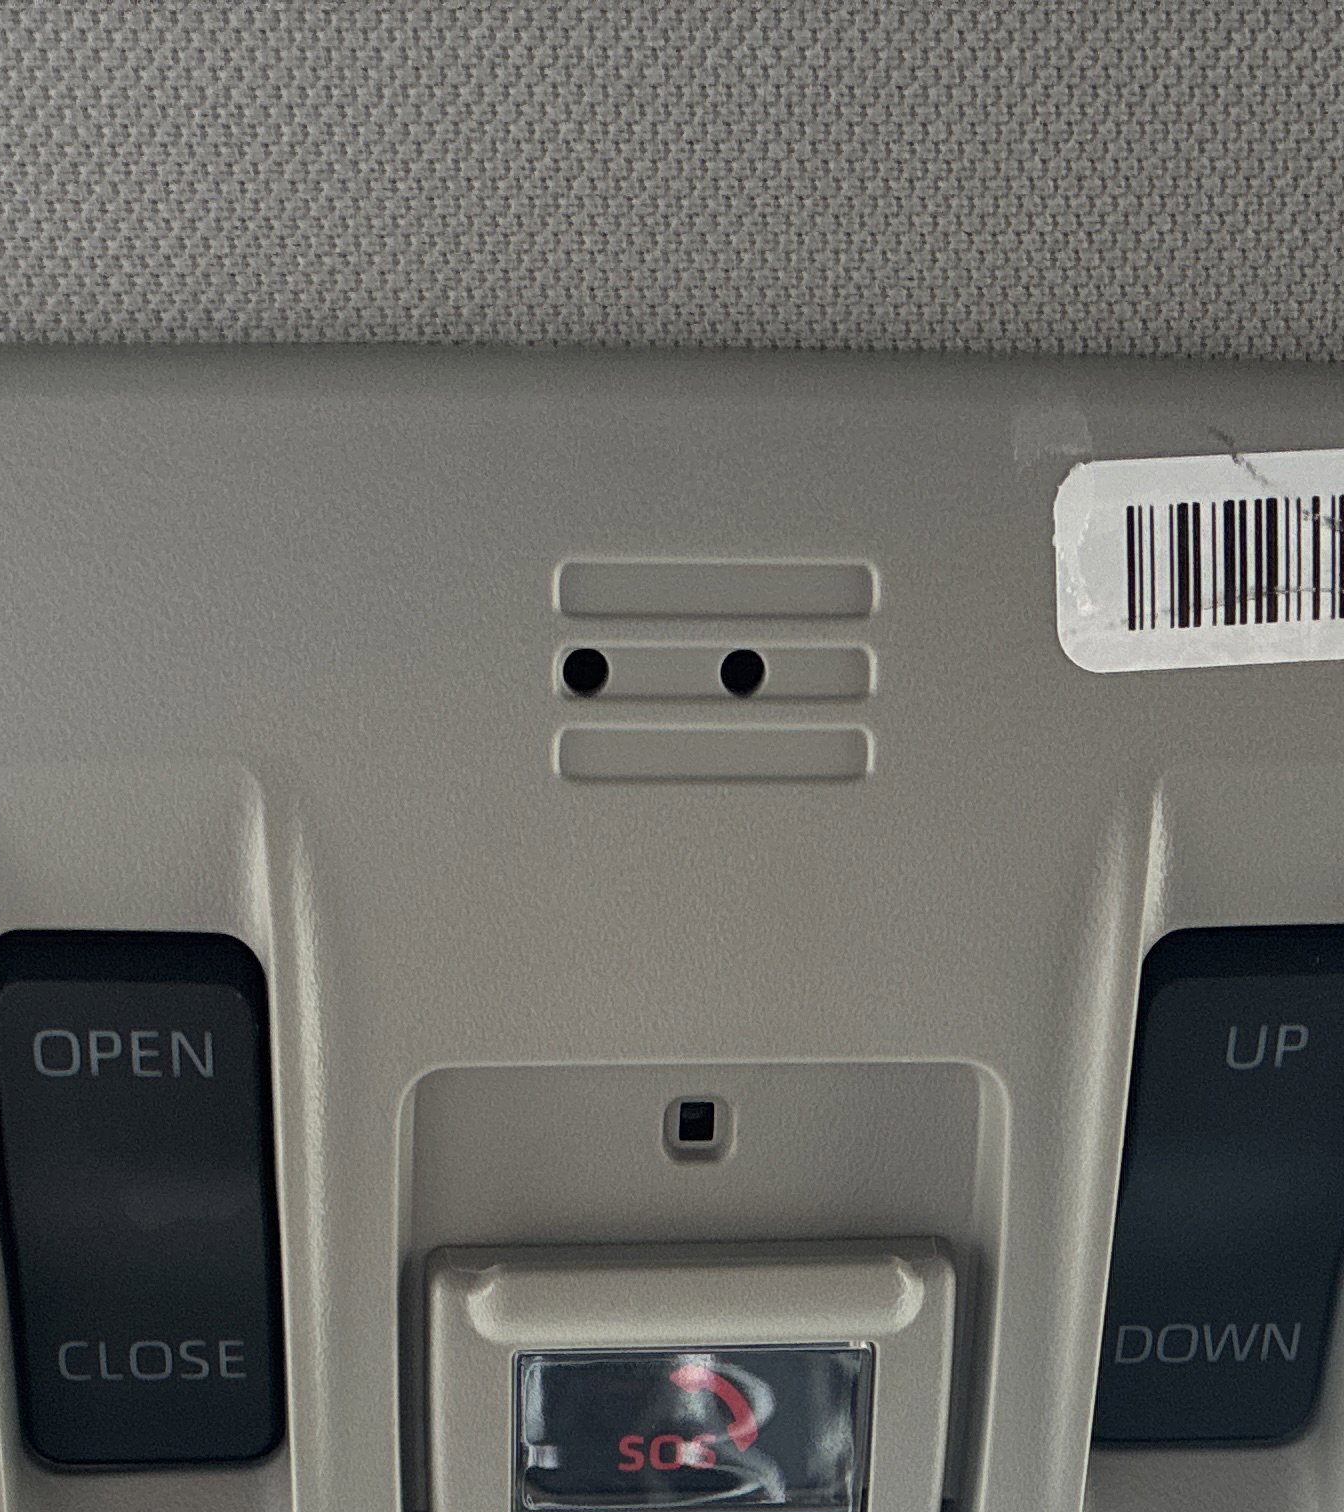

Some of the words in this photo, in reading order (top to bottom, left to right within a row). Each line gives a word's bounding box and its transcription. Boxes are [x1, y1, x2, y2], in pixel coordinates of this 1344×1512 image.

[32, 1029, 215, 1078] OPEN
[1225, 1024, 1309, 1071] UP
[58, 1339, 247, 1382] CLOSE
[1114, 1322, 1302, 1364] DOWN
[617, 1433, 717, 1472] SOS
